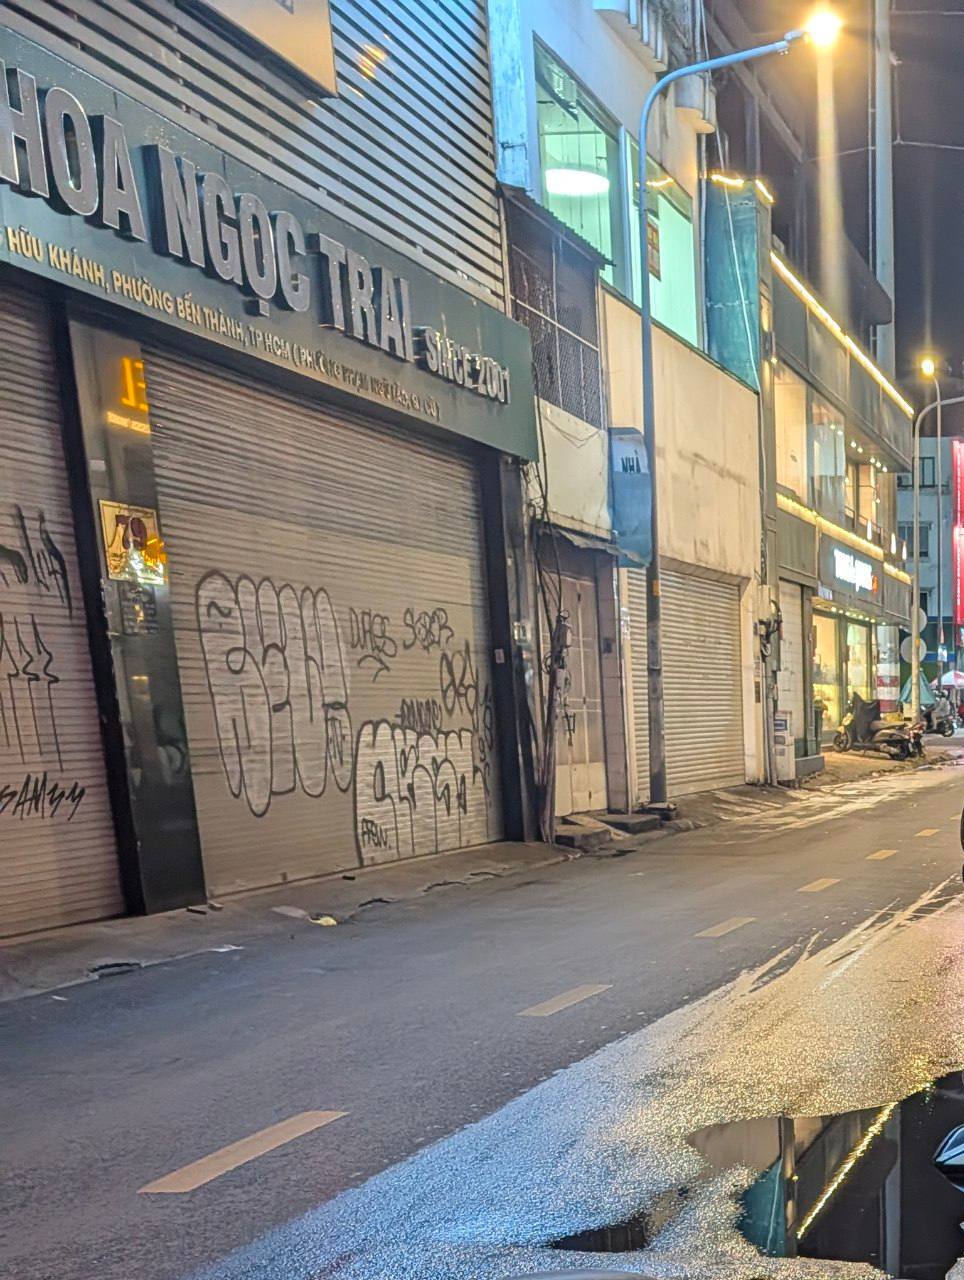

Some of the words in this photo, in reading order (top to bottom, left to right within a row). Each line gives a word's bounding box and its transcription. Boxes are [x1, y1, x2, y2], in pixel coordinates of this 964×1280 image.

[48, 243, 110, 293] KHÁNH,
[112, 270, 174, 314] PHƯỜNG
[176, 291, 201, 325] BẾN
[203, 306, 249, 347] THÀNH,
[265, 333, 290, 360] HCM
[156, 145, 311, 316] NGỌC
[318, 232, 415, 364] TRAI
